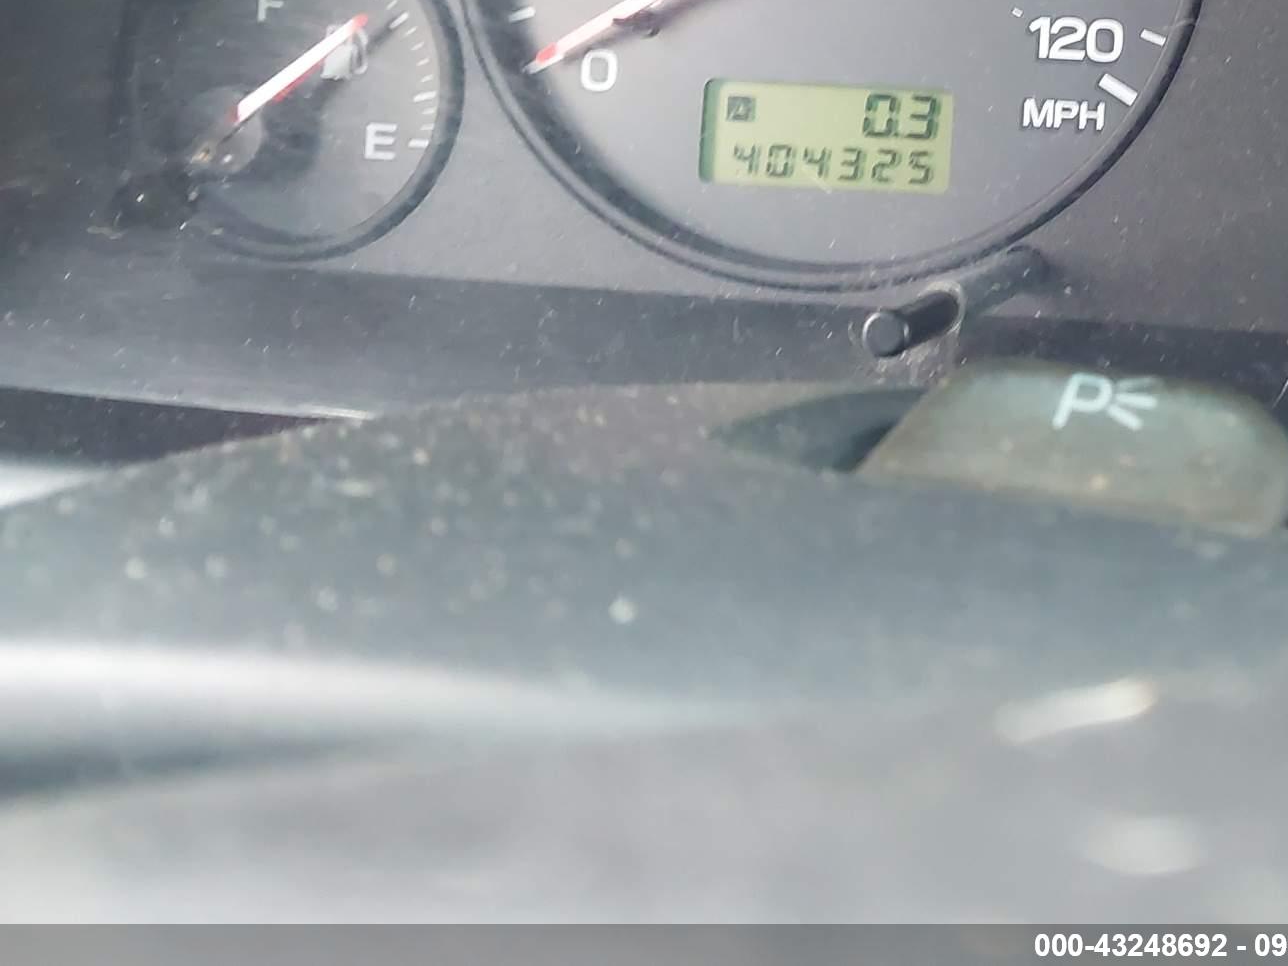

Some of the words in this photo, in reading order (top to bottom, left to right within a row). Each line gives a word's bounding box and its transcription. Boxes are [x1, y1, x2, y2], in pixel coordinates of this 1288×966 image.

[1028, 15, 1125, 64] 120
[580, 48, 619, 92] 0
[1021, 97, 1106, 132] MPH
[364, 122, 398, 161] E
[733, 143, 935, 186] 404325
